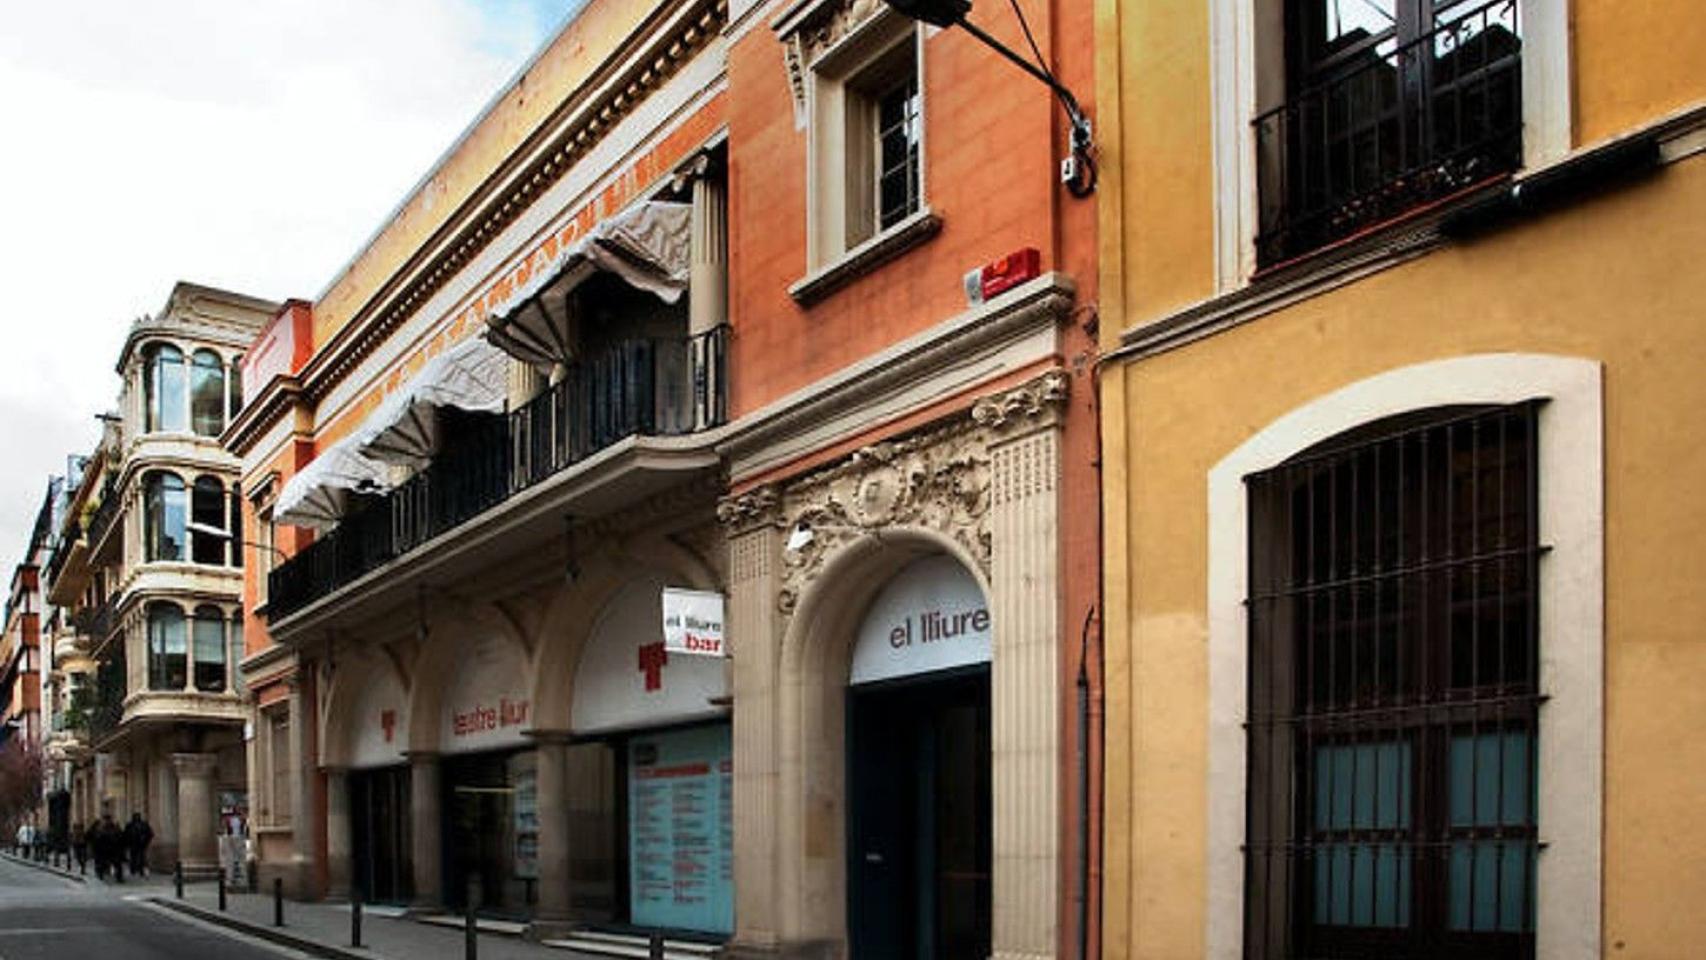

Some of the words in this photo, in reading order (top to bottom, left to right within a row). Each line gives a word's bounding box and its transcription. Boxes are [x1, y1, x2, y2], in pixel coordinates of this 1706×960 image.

[685, 632, 721, 652] bar
[890, 617, 912, 649] el
[921, 608, 990, 644] lliure
